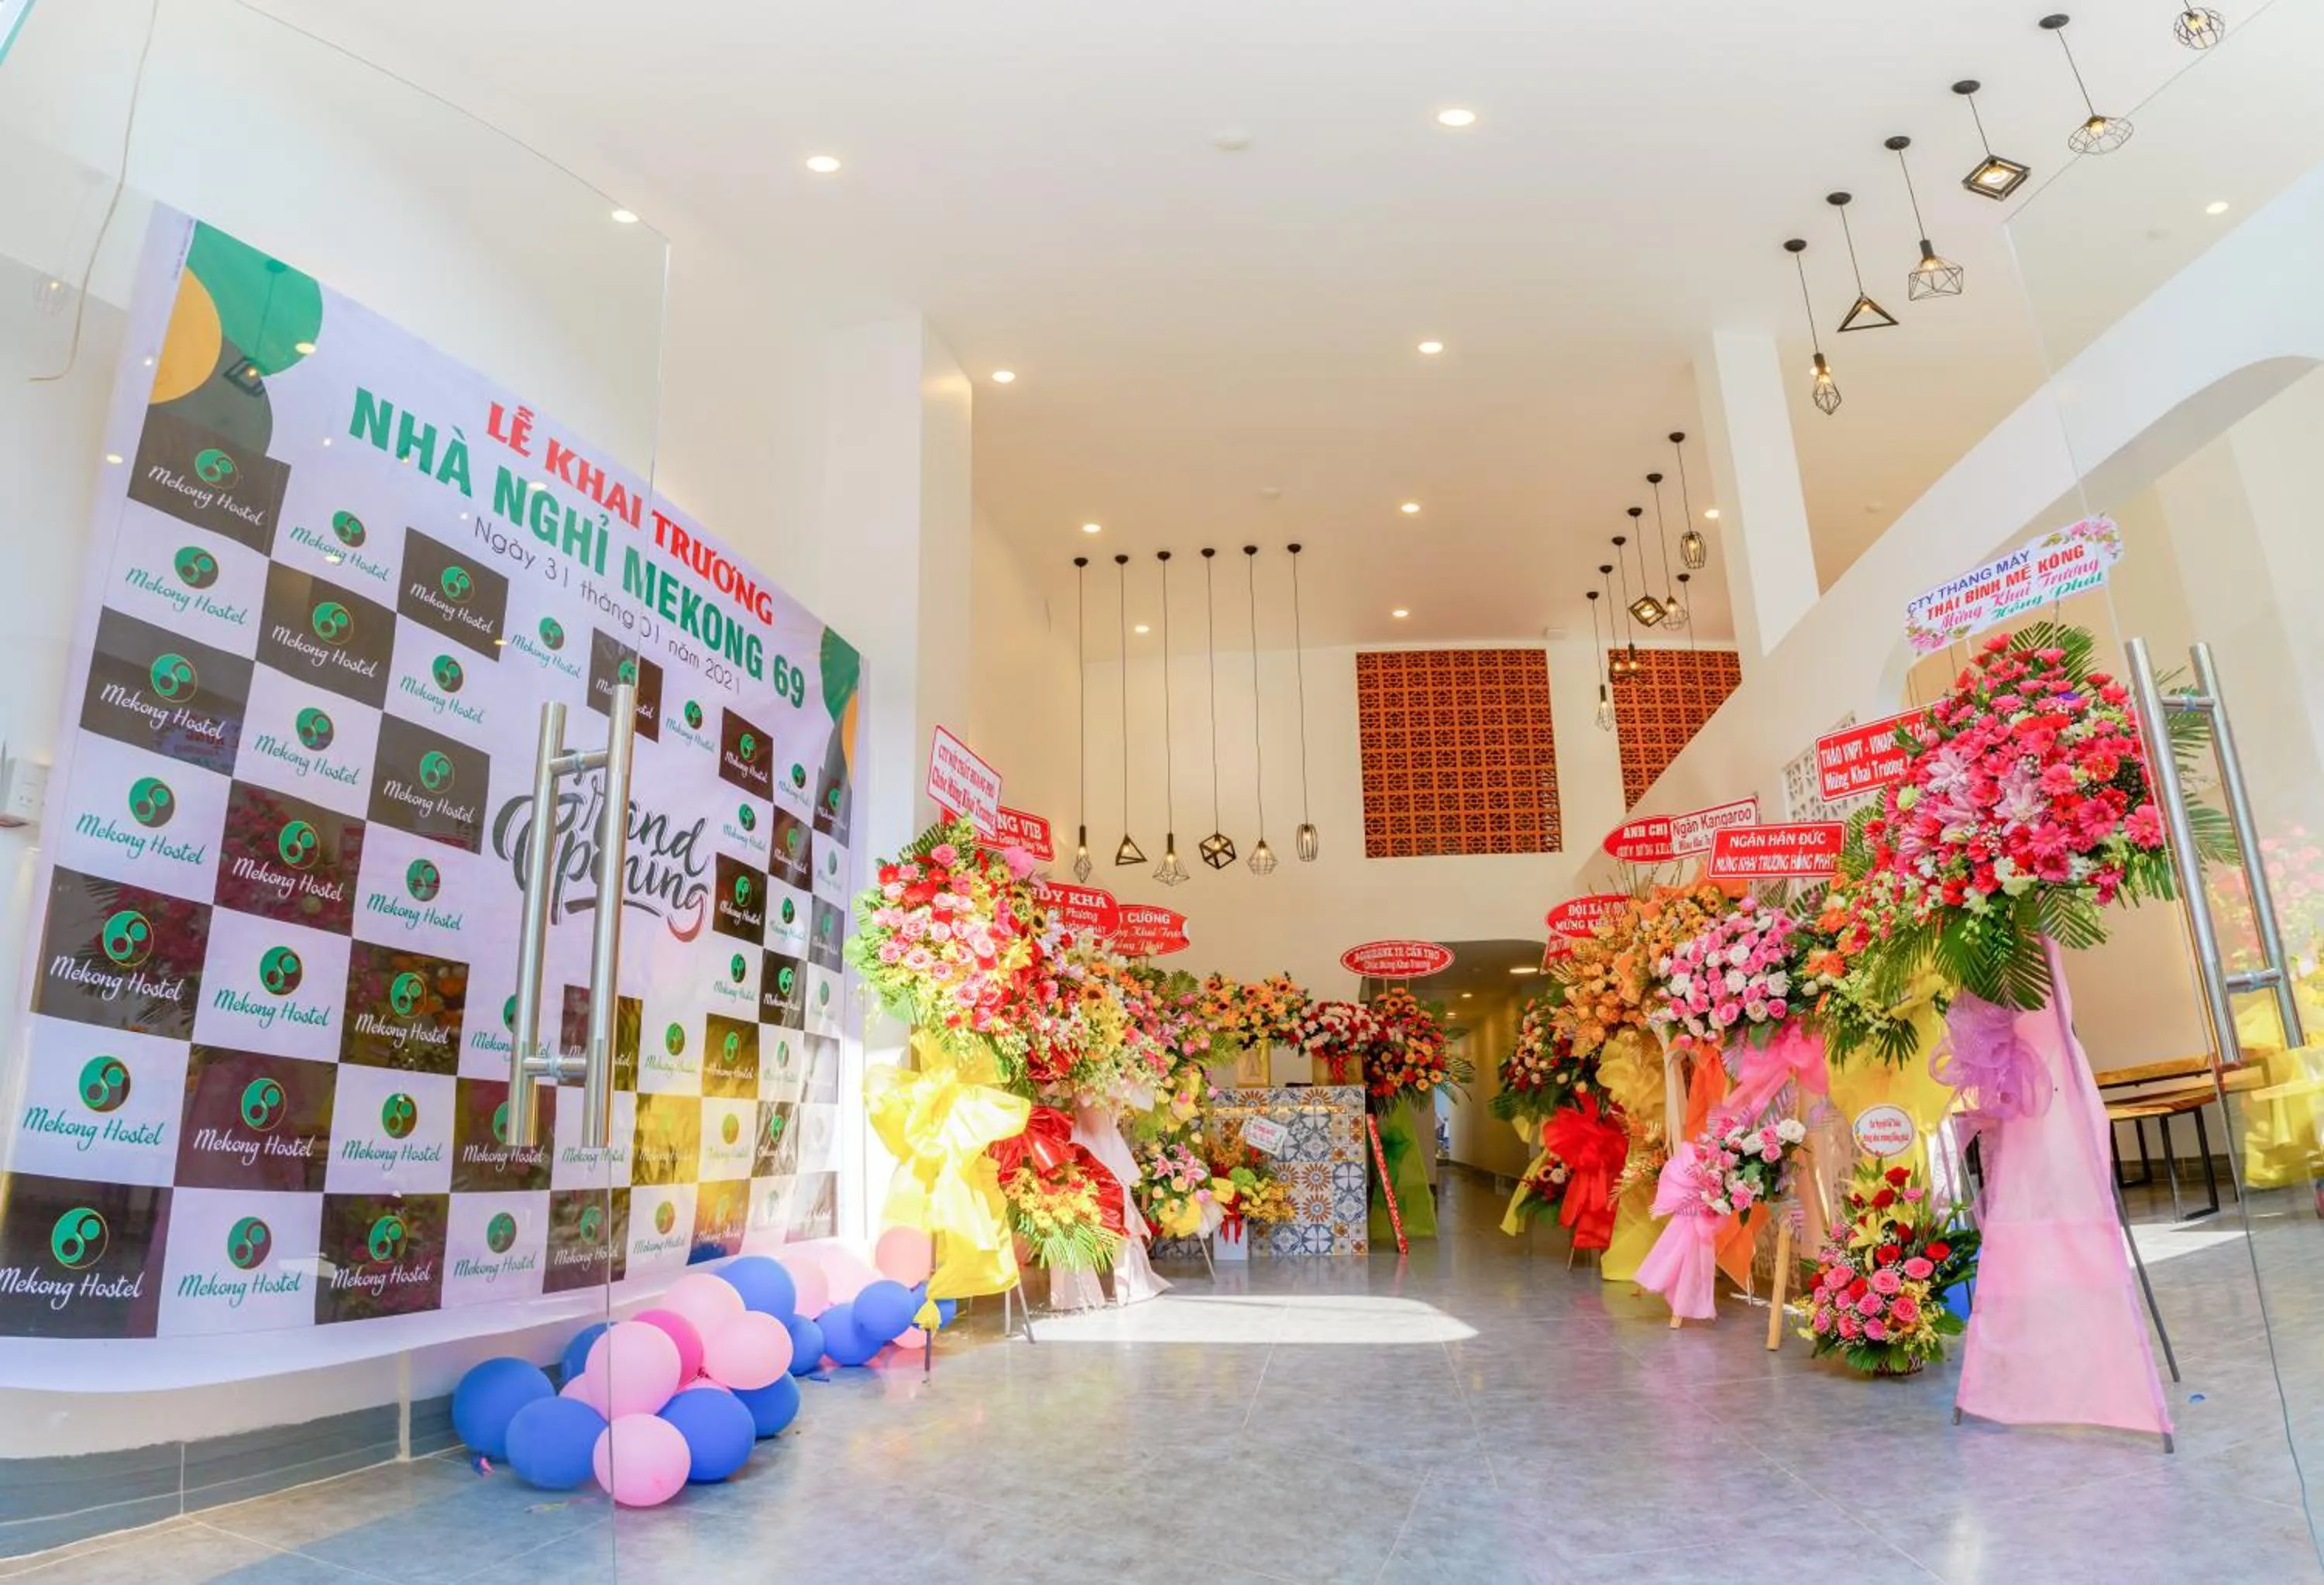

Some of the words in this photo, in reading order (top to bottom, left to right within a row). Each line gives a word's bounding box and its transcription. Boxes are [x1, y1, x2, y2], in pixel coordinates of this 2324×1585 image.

[148, 466, 213, 508] Mekong
[217, 492, 266, 527] Hostel
[486, 401, 535, 457] LỄ
[545, 437, 643, 530] KHAI
[651, 508, 773, 626] TRƯƠNG
[290, 526, 347, 565] Mekong
[351, 551, 390, 582] Hostel
[349, 386, 472, 498] NHÀ
[493, 465, 610, 576] NGHỈ
[622, 545, 763, 680] MEKONG
[773, 654, 806, 709] 69
[125, 568, 191, 612] Mekong
[194, 594, 249, 624] Hostel
[410, 583, 456, 621] Mekong
[459, 607, 494, 634] Hostel
[474, 516, 536, 570] Ngày
[545, 557, 569, 588] 31
[580, 580, 634, 630] tháng
[668, 638, 700, 669] năm
[705, 658, 741, 693] 2021
[1907, 593, 1934, 613] CTY
[1937, 568, 1992, 597] THANG
[1991, 582, 2030, 607] Khai
[272, 625, 328, 666] Mekong
[332, 648, 379, 679] Hostel
[101, 683, 169, 729] Mekong
[173, 708, 226, 739] Hostel
[400, 676, 445, 713] Mekong
[449, 696, 485, 724] Hostel
[254, 734, 310, 776] Mekong
[314, 757, 361, 786] Hostel
[383, 781, 435, 818] Mekong
[436, 791, 476, 823] Hostel
[76, 813, 146, 858] Mekong
[150, 835, 207, 865] Hostel
[232, 856, 295, 898] Mekong
[299, 875, 345, 902] Hostel
[366, 893, 421, 930] Mekong
[424, 907, 464, 931] Hostel
[50, 955, 122, 999] Mekong
[128, 973, 185, 1001] Hostel
[213, 988, 276, 1029] Mekong
[280, 1001, 331, 1026] Hostel
[355, 1013, 407, 1046] Mekong
[410, 1023, 451, 1045] Hostel
[470, 1032, 513, 1061] Mekon
[23, 1107, 98, 1150] Mekong
[103, 1119, 165, 1146] Hostel
[193, 1128, 260, 1166] Mekong
[264, 1135, 315, 1157] Hostel
[342, 1140, 397, 1171] Mekong
[401, 1142, 443, 1162] Hostel
[463, 1145, 507, 1171] Mekong
[511, 1145, 545, 1164] Hostel
[331, 1267, 386, 1295] Mekong
[390, 1263, 431, 1283] Hostel
[500, 1251, 538, 1271] Hostel
[0, 1266, 74, 1310] Mekong
[80, 1271, 145, 1298] Hostel
[177, 1274, 246, 1308] Mekong
[252, 1270, 303, 1293] Hostel
